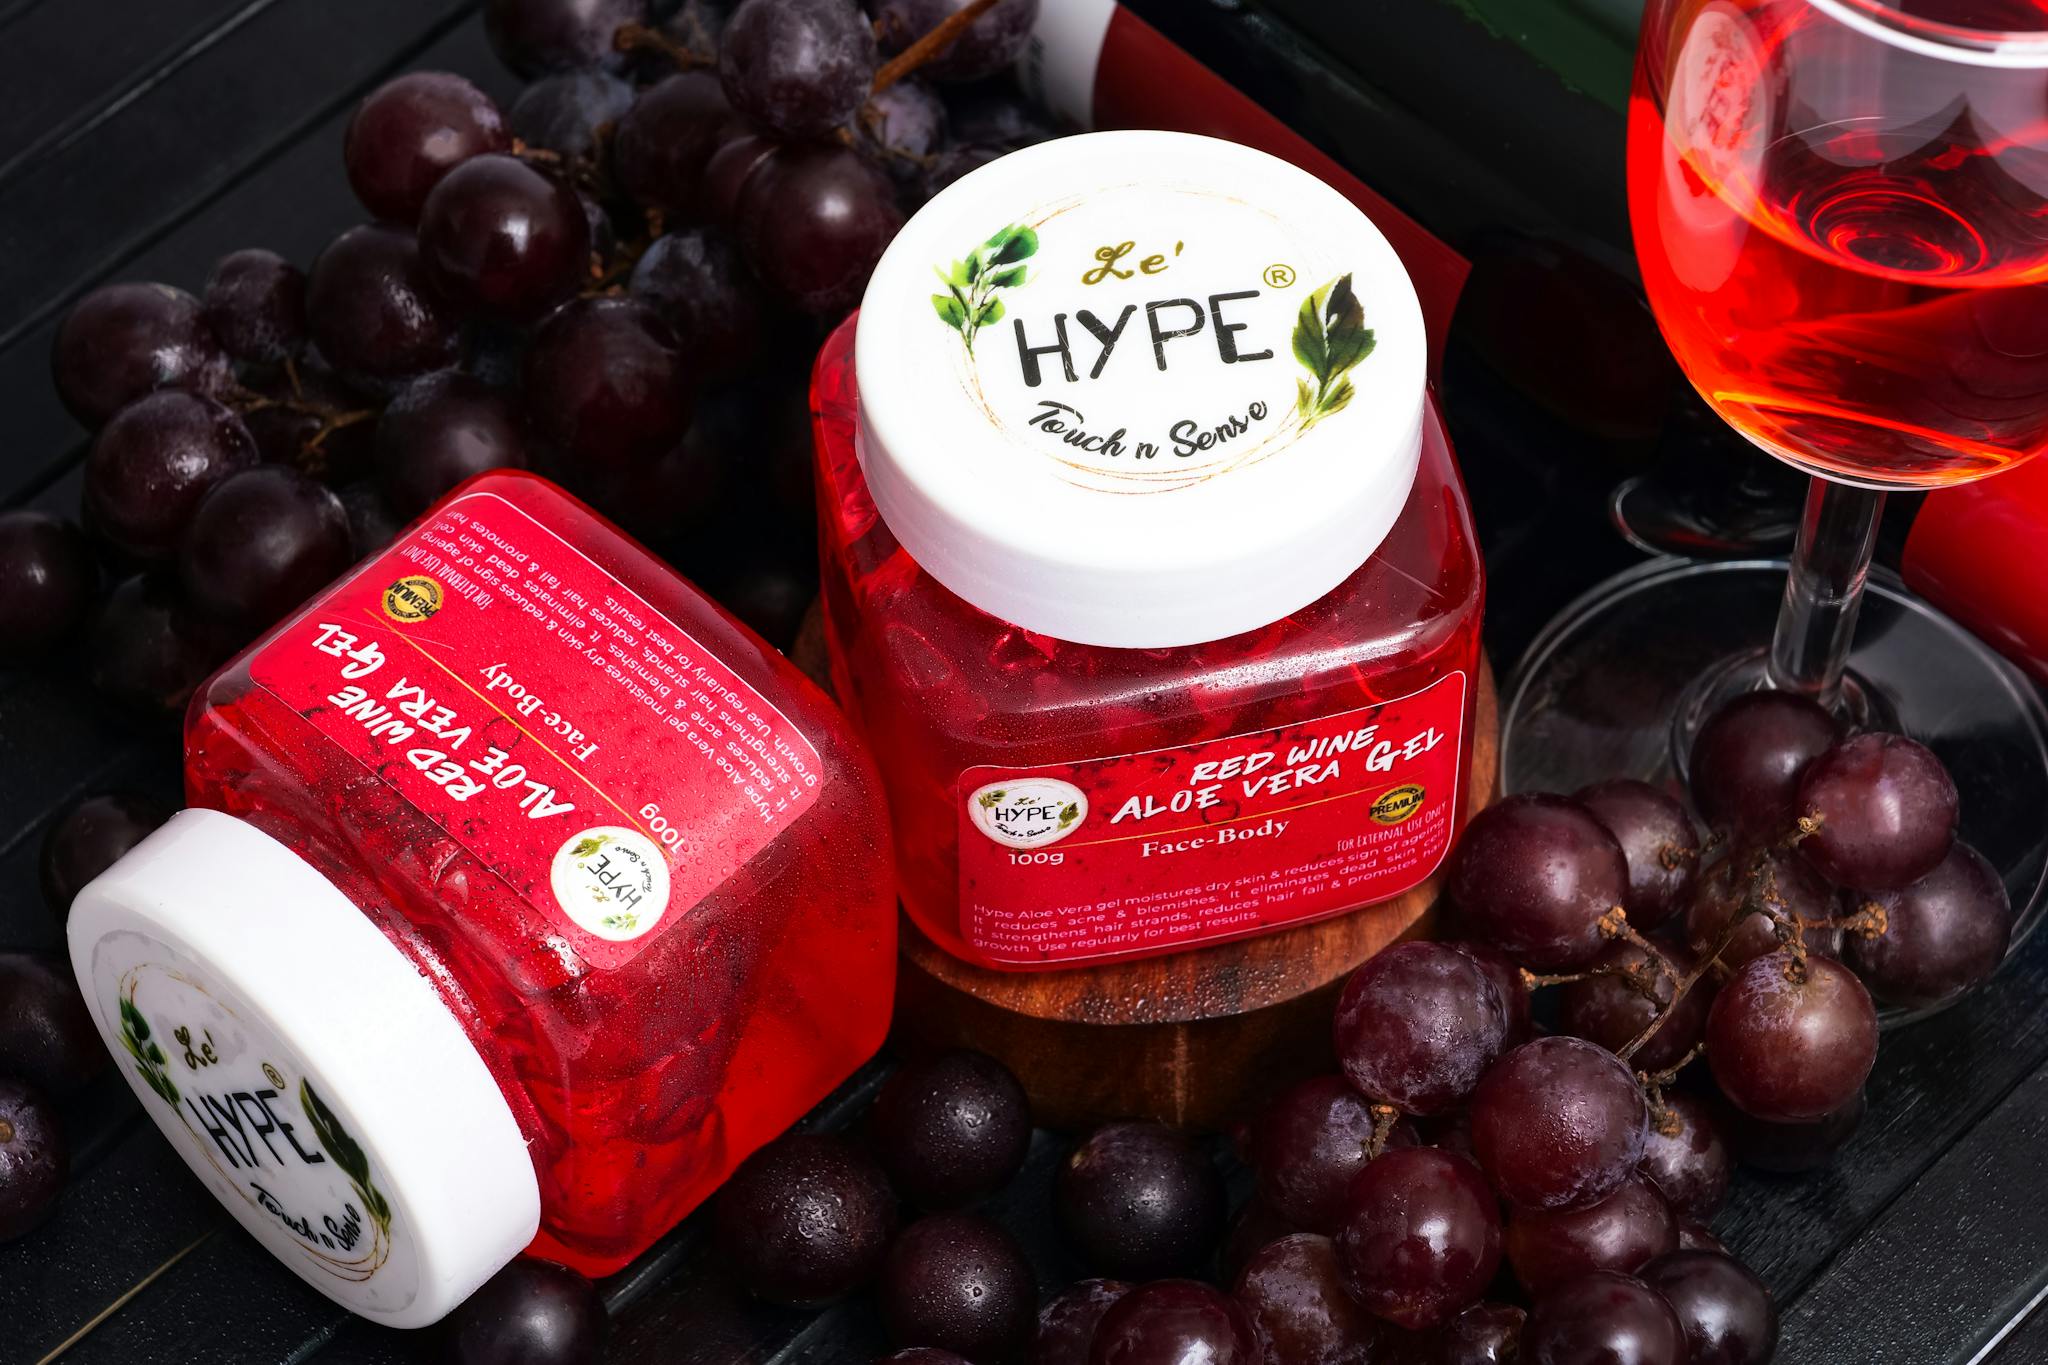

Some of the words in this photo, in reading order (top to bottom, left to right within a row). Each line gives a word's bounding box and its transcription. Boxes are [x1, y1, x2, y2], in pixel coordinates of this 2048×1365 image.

[1014, 291, 1273, 387] HYPE
[1029, 401, 1126, 456] Touch
[1135, 443, 1159, 459] n
[1170, 401, 1267, 457] Sense
[445, 510, 469, 525] hair
[454, 554, 474, 567] of
[457, 532, 485, 554] skin
[469, 520, 529, 563] promotes
[472, 563, 501, 586] sign
[484, 553, 520, 579] dead
[526, 560, 540, 573] &
[537, 570, 561, 590] fall
[387, 580, 439, 618] PREMIUM
[497, 582, 548, 622] reduces
[522, 578, 586, 629] eliminates
[560, 587, 589, 610] hair
[545, 618, 559, 631] &
[556, 626, 585, 650] skin
[587, 606, 639, 647] reduces
[588, 628, 602, 643] It
[644, 628, 675, 656] best
[311, 623, 385, 679] GEL
[581, 646, 606, 666] dry
[641, 644, 690, 688] strands,
[671, 651, 694, 670] for
[603, 663, 667, 716] moistures
[673, 696, 687, 710] &
[688, 688, 718, 713] hair
[690, 665, 748, 714] regularly
[327, 685, 414, 744] WINE
[385, 676, 471, 750] VERA
[479, 662, 599, 761] Face-Body
[661, 712, 690, 733] gel
[689, 710, 723, 739] acne
[746, 711, 772, 738] Use
[685, 730, 715, 760] Vera
[717, 709, 792, 784] strengthens
[773, 733, 818, 787] growth.
[1189, 751, 1275, 785] RED
[1286, 724, 1379, 766] WINE
[406, 748, 486, 801] RED
[468, 746, 575, 818] ALOE
[715, 755, 747, 785] Aloe
[725, 740, 775, 793] reduces
[1110, 783, 1222, 823] ALOE
[1242, 759, 1339, 797] VERA
[1365, 727, 1444, 771] GEL
[742, 784, 774, 824] Hype
[775, 795, 788, 812] It
[788, 784, 802, 800] It
[1369, 790, 1425, 816] PREMIUM
[639, 802, 685, 854] 100g
[995, 805, 1055, 821] HYPE
[1142, 819, 1288, 857] Face-Body
[1008, 852, 1063, 865] 100g
[586, 853, 643, 911] HYPE
[974, 904, 1014, 919] Hype
[1017, 909, 1054, 920] Aloe
[1056, 903, 1092, 916] Vera
[1095, 897, 1120, 912] gel
[1124, 885, 1202, 906] moistures
[1205, 881, 1230, 892] dry
[1234, 873, 1266, 887] skin
[1269, 869, 1280, 879] &
[1283, 856, 1345, 876] reduces
[1346, 847, 1379, 862] sign
[1382, 840, 1398, 853] of
[974, 915, 983, 924] It
[994, 920, 1058, 930] reduces
[1067, 913, 1106, 926] acne
[1115, 908, 1127, 919] &
[1229, 889, 1240, 899] It
[1249, 871, 1330, 895] eliminates
[1338, 857, 1377, 875] dead
[1385, 846, 1416, 863] skin
[973, 925, 982, 935] It
[991, 928, 1087, 942] strengthens
[1093, 921, 1124, 933] hair
[1130, 910, 1192, 928] strands,
[1198, 898, 1260, 917] reduces
[1265, 890, 1295, 904] hair
[1301, 882, 1324, 896] fall
[1330, 878, 1341, 889] &
[1347, 857, 1418, 887] promotes
[1037, 941, 1067, 952] Use
[1070, 931, 1140, 948] regularly
[1143, 927, 1164, 938] for
[1168, 920, 1201, 934] best
[185, 1089, 325, 1169] HYPE
[250, 1182, 319, 1246] Touch
[323, 1203, 361, 1252] Sense
[320, 1231, 337, 1250] n
